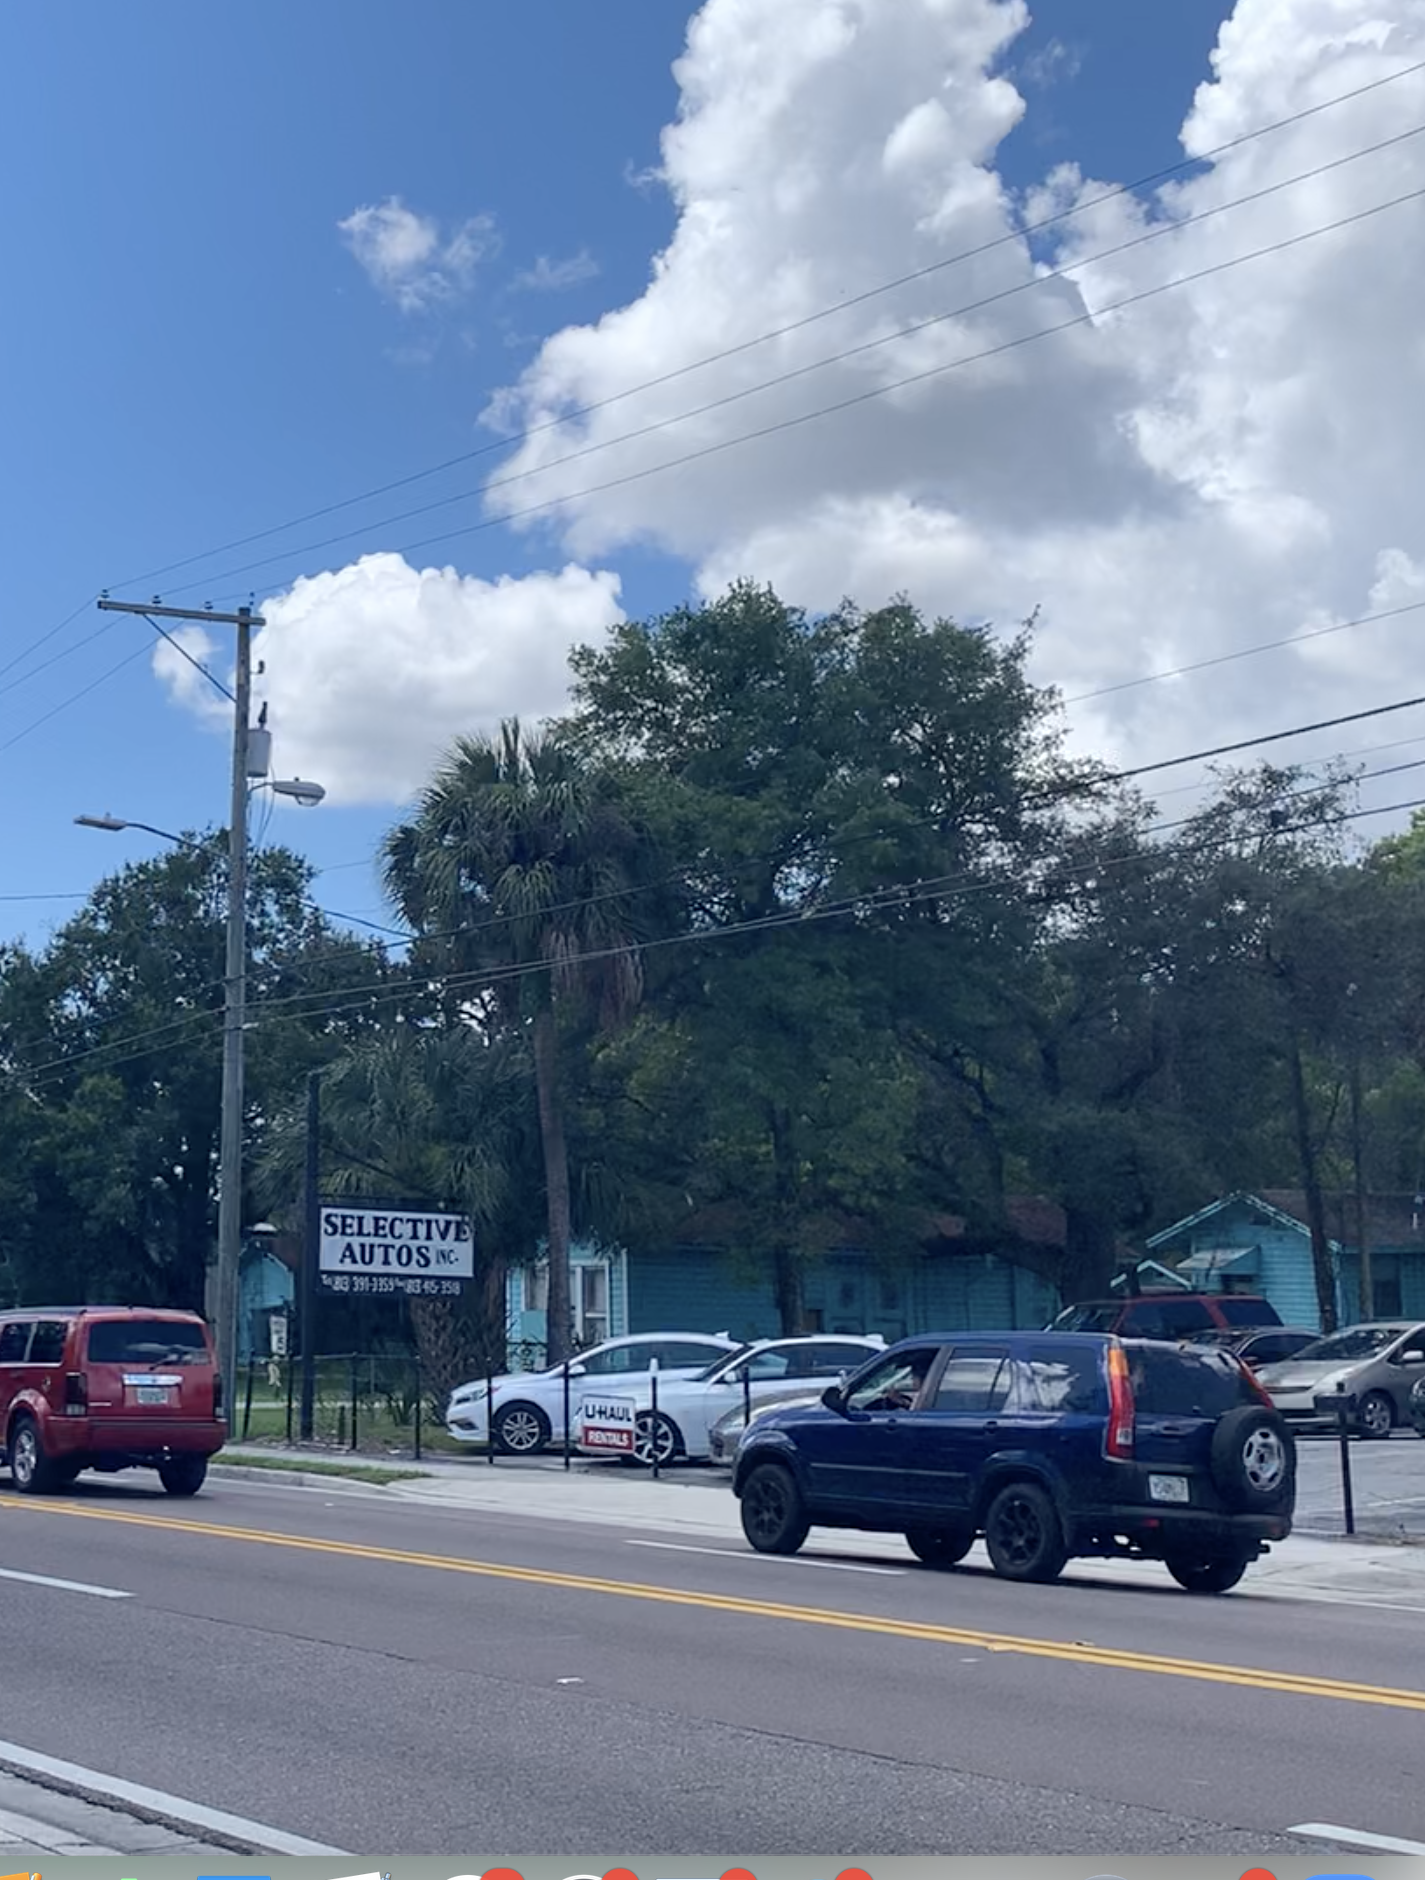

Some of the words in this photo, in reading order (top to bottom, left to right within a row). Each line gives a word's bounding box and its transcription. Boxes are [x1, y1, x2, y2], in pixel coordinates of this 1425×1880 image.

[323, 1213, 472, 1242] SELECTIVE
[339, 1243, 431, 1268] AUTOS
[588, 1430, 629, 1447] RENTALS
